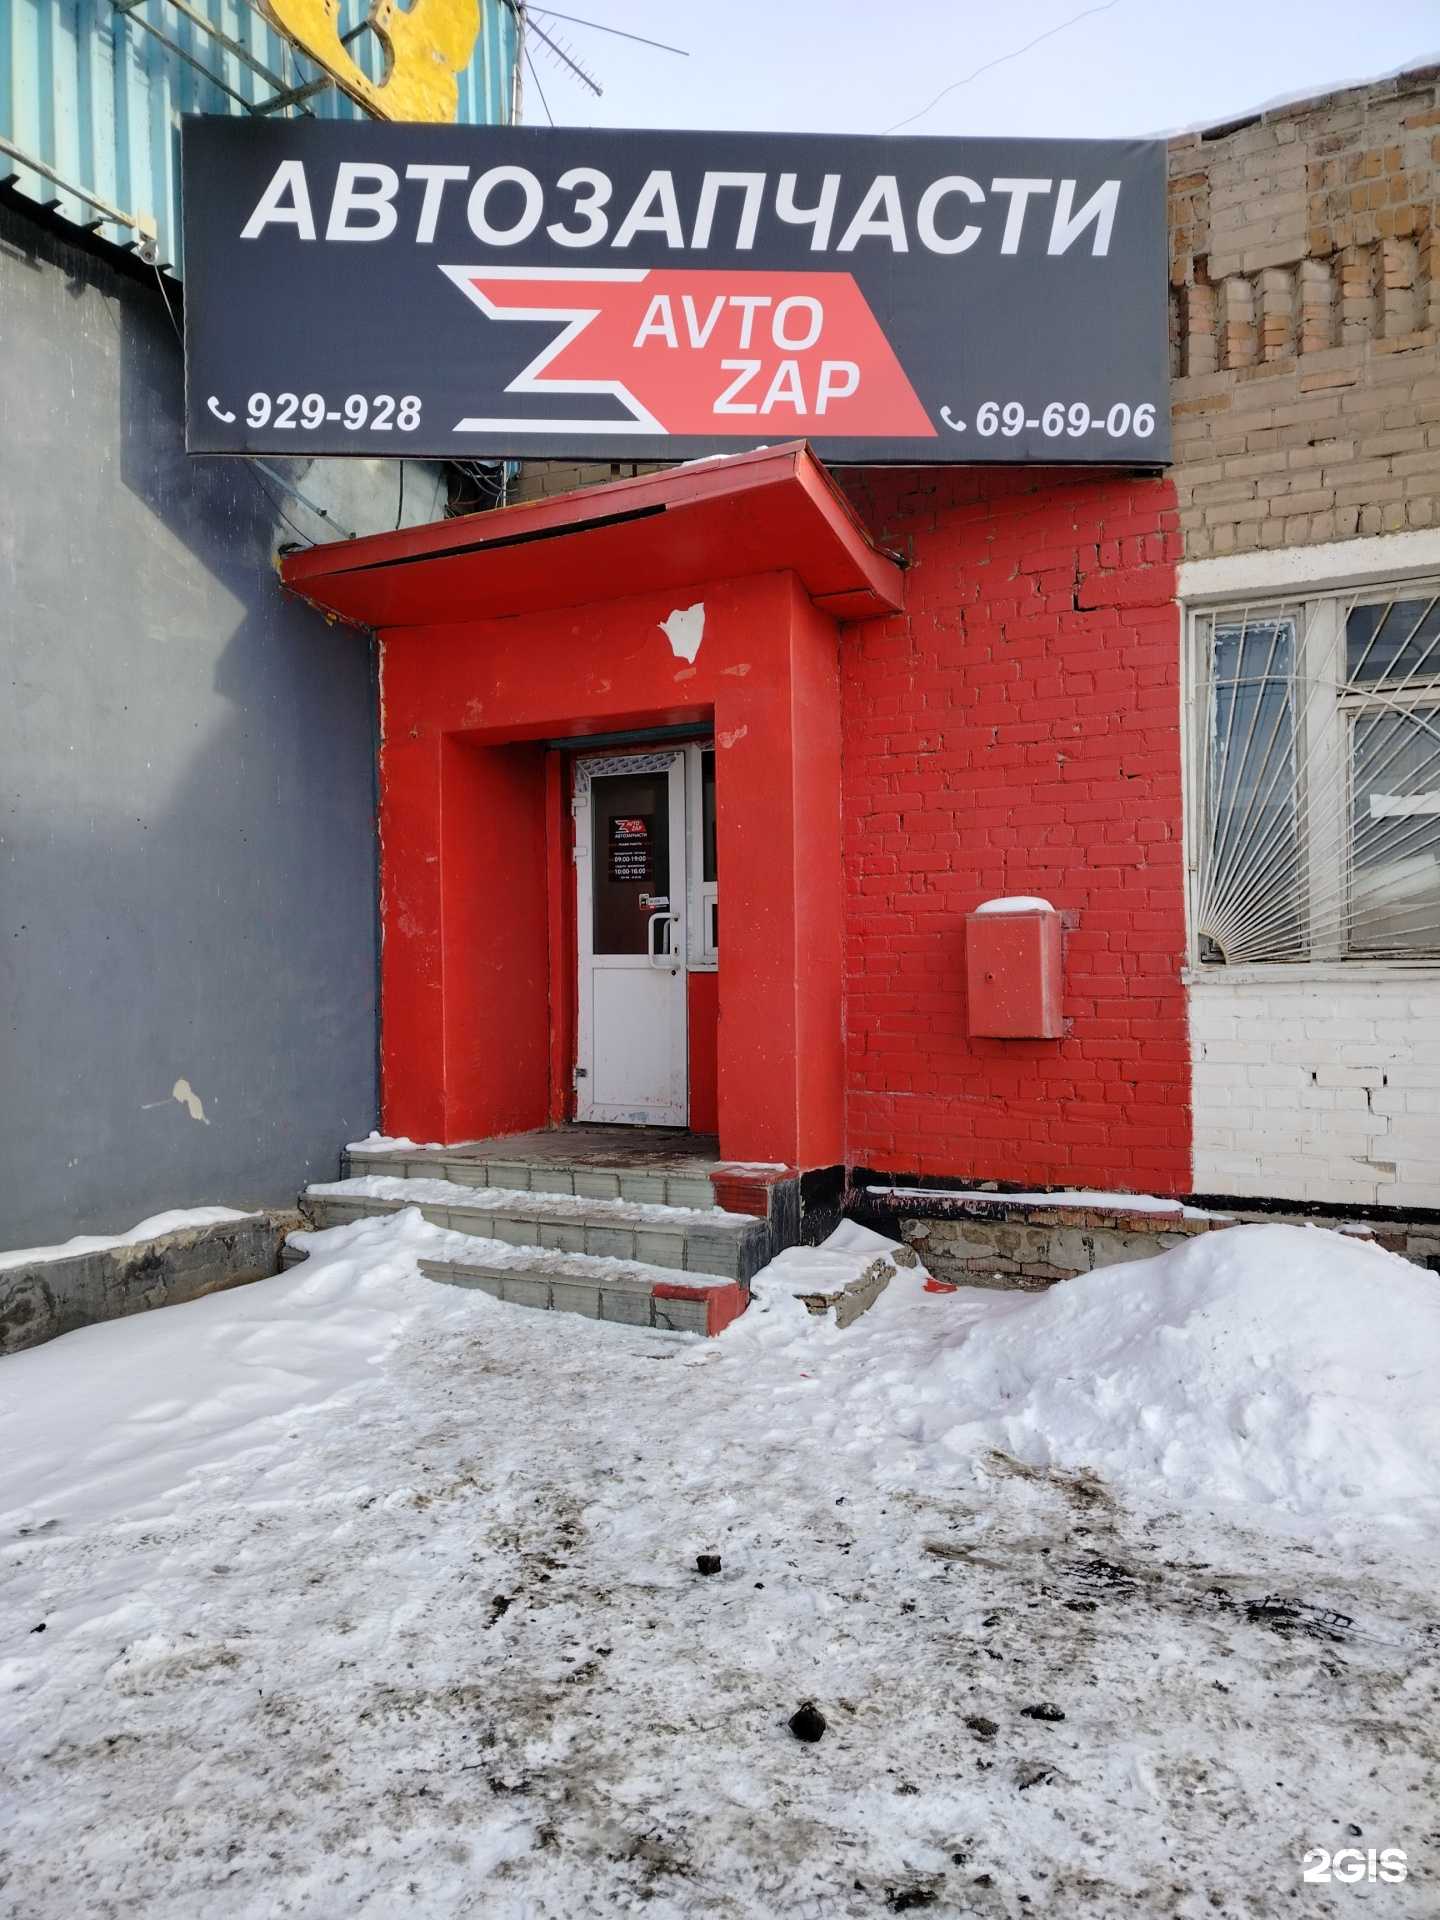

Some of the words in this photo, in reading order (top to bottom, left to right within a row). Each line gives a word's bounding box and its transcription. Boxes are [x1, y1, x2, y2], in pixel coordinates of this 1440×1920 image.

[240, 160, 1123, 258] АВТОЗАПЧАСТИ
[632, 294, 825, 350] AVTO
[246, 393, 423, 433] 929-928
[713, 360, 862, 415] ZAP
[976, 402, 1157, 439] 69-69-06
